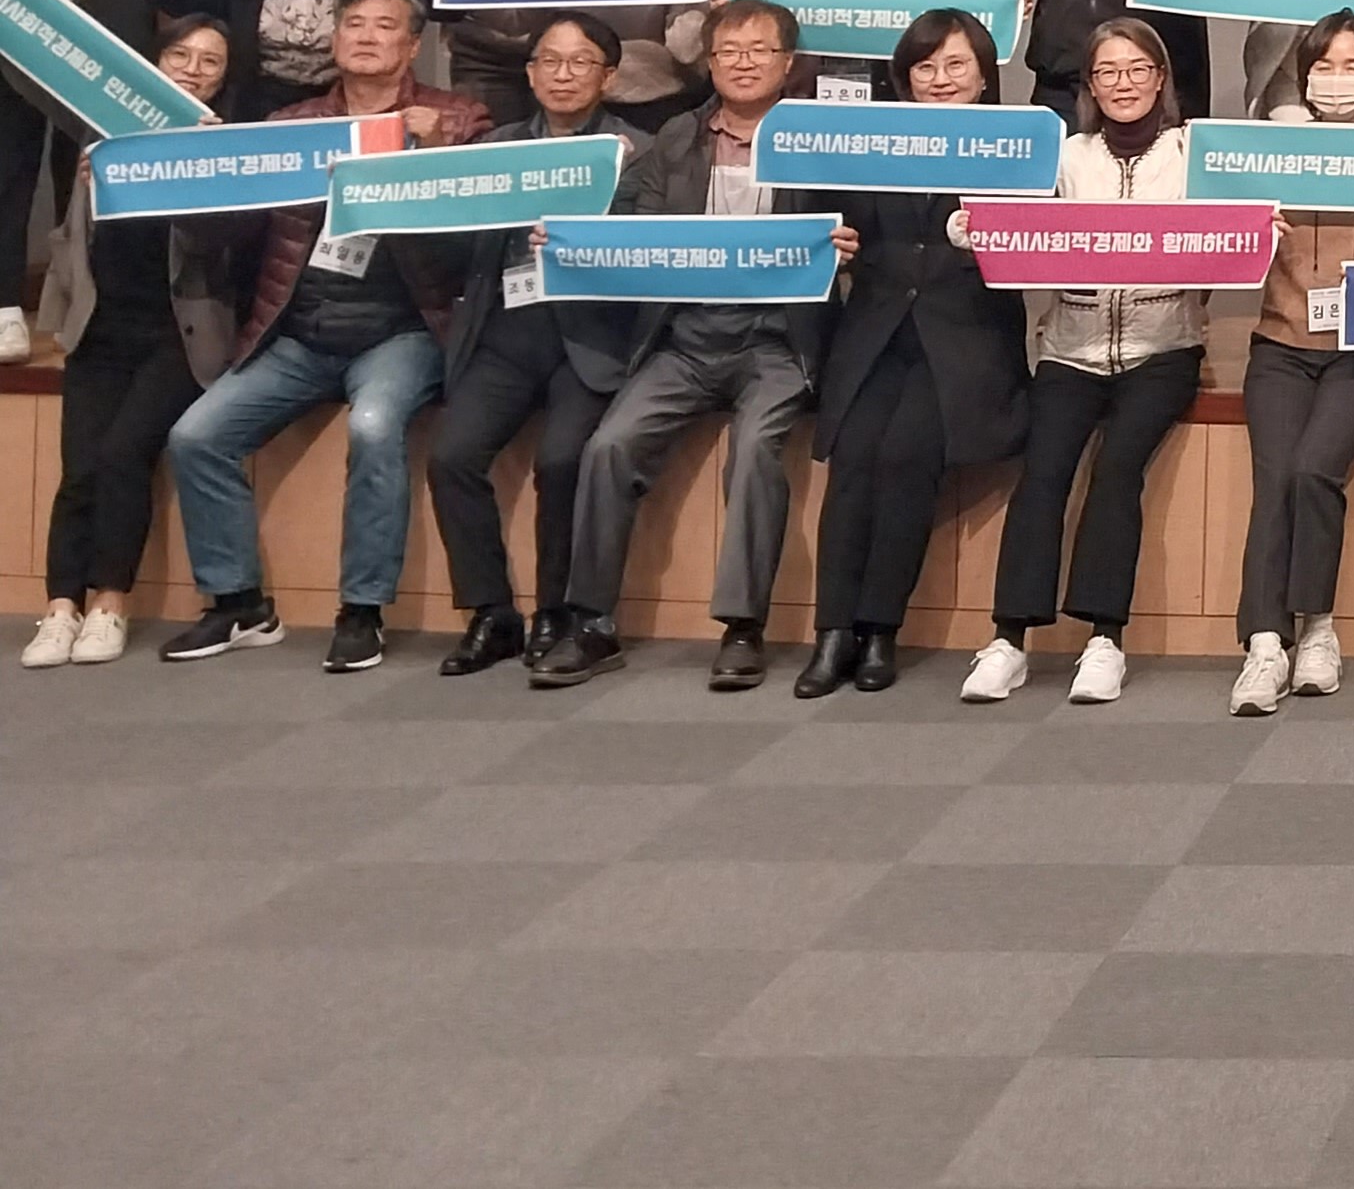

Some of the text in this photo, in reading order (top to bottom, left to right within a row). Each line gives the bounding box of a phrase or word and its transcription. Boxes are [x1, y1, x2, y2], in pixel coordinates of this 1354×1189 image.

[103, 73, 171, 131] 만나다!!
[774, 132, 1033, 160] 안산시사회적경제와 나누다!!
[106, 152, 305, 185] 안산시사회적경제와
[343, 166, 593, 206] 안산시사회적경제와 만나다!!
[969, 228, 1260, 255] 안산시사회적경제와 함께하다!!
[556, 248, 812, 270] 안산시사회적경제와 나누다!!
[1311, 301, 1340, 321] 김은
